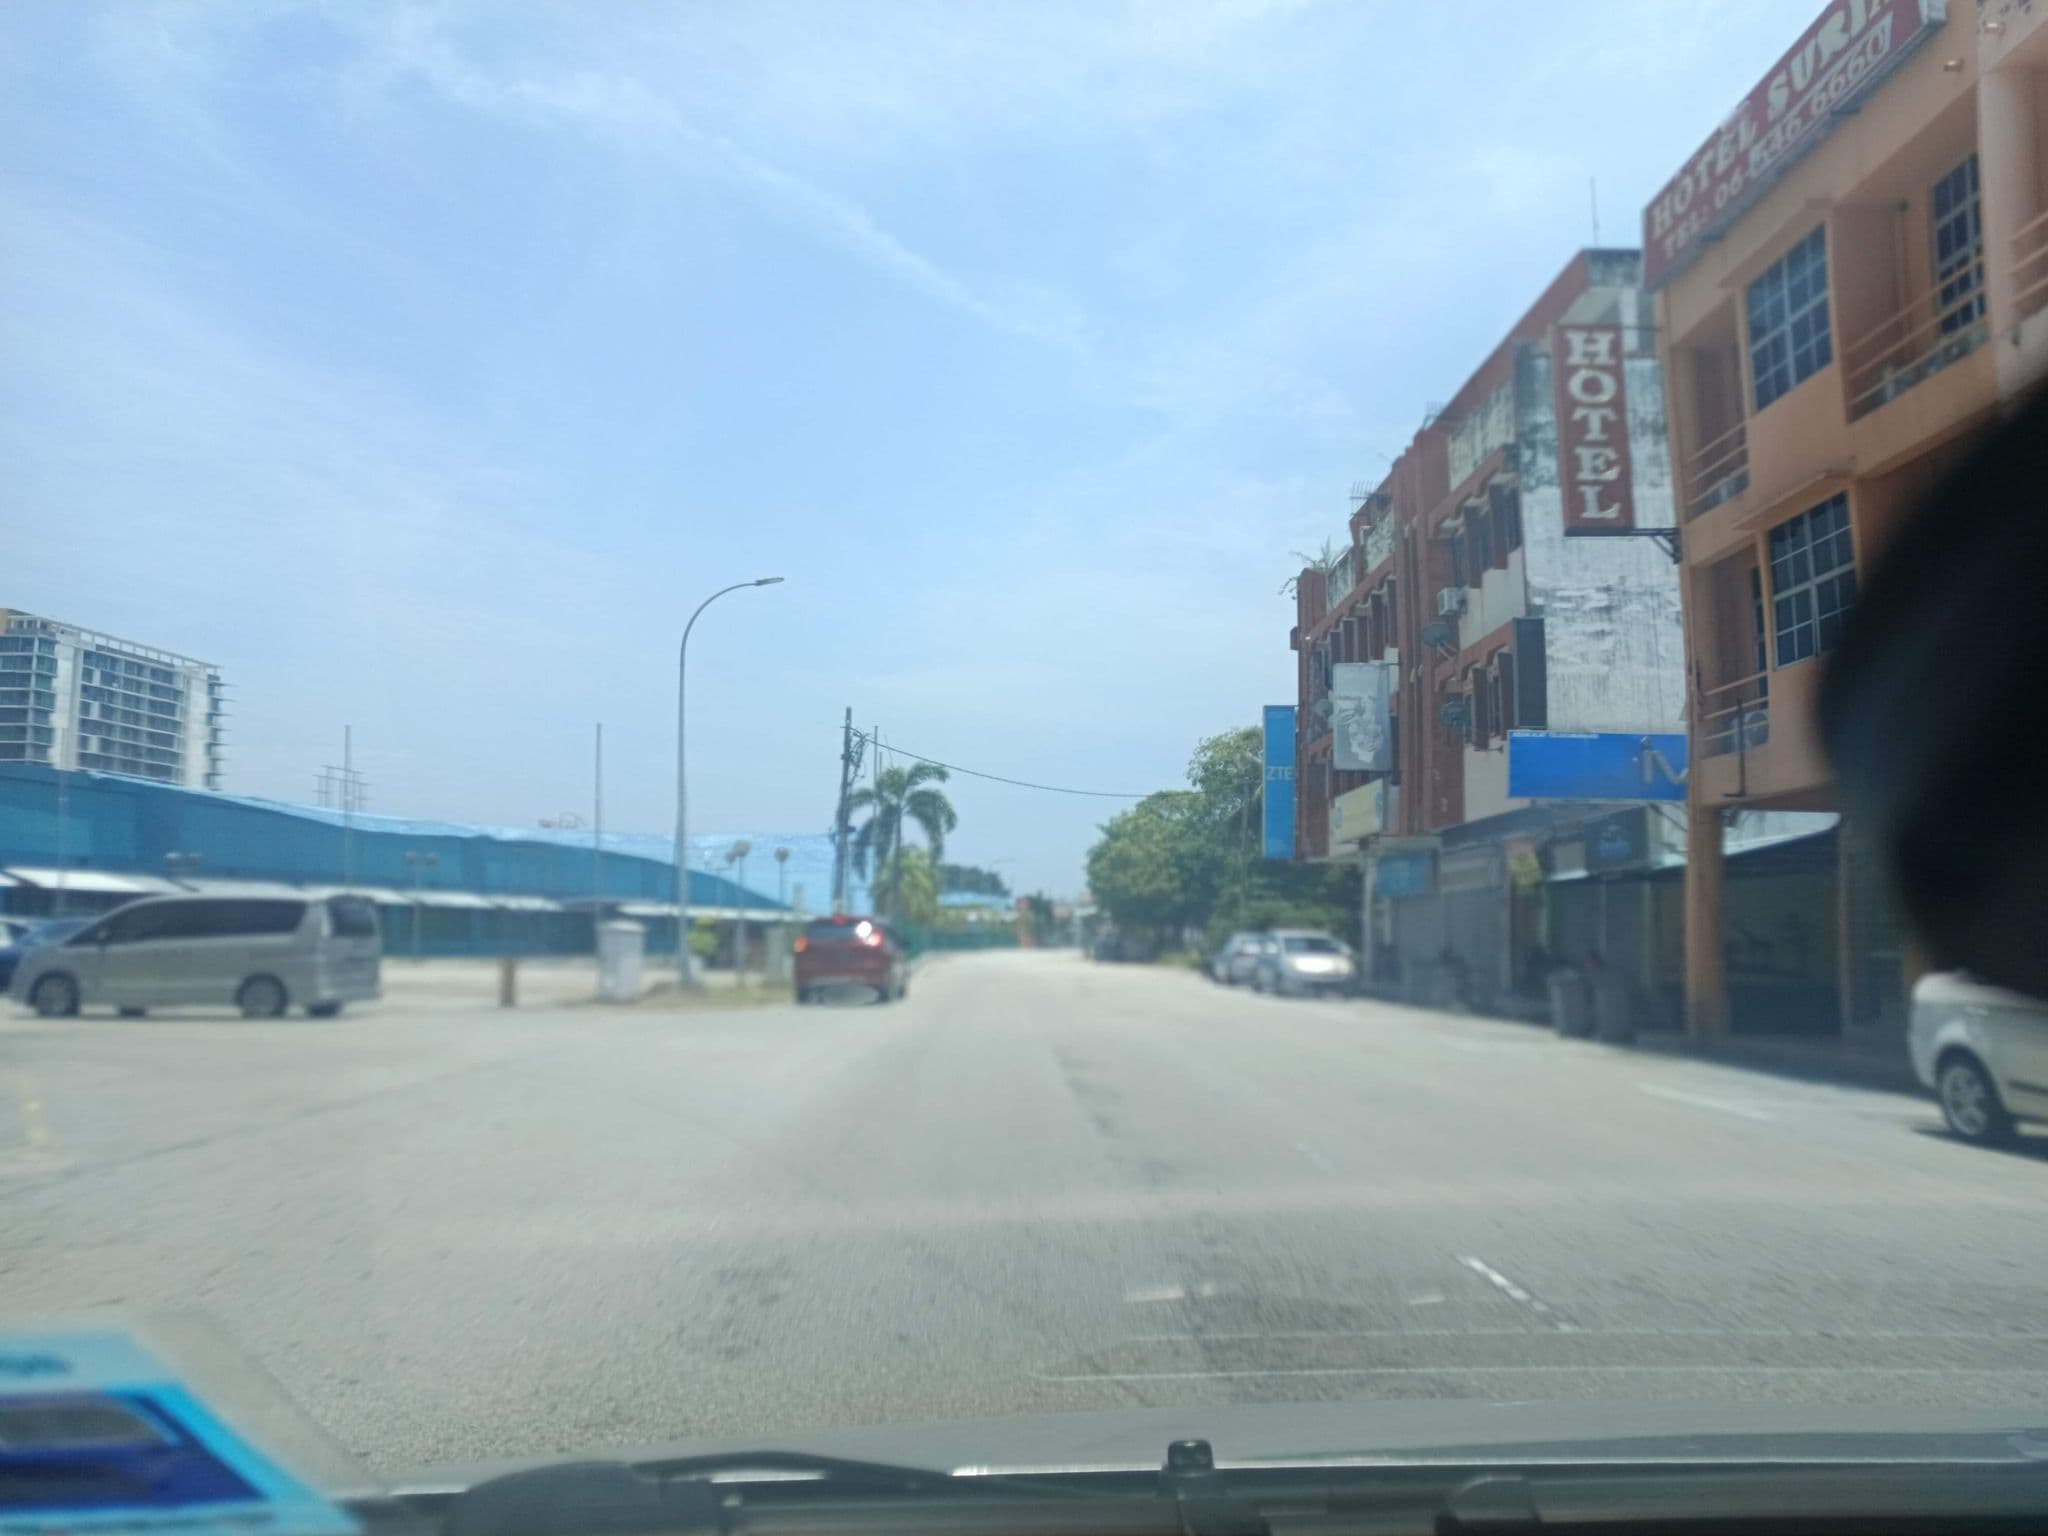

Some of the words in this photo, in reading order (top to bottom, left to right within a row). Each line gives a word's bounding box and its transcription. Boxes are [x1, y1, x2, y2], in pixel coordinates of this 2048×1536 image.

[1652, 112, 1757, 240] HOTEL
[1565, 331, 1622, 519] HOTEL
[1266, 766, 1294, 781] ZTE
